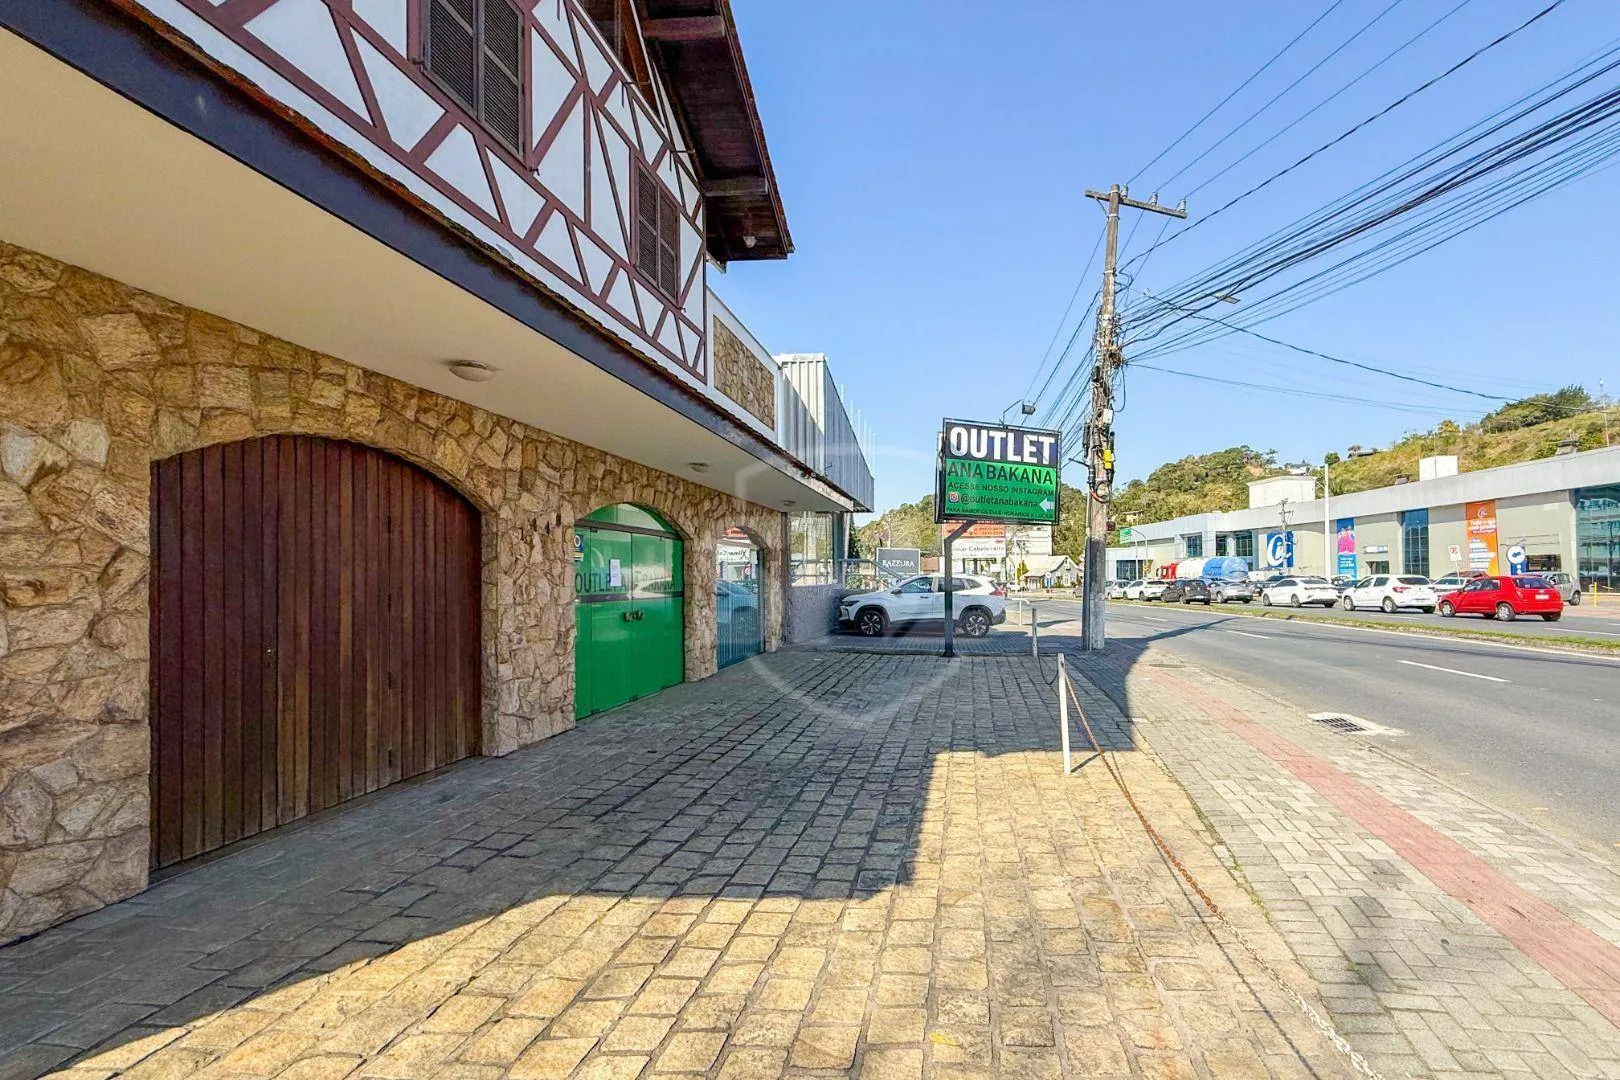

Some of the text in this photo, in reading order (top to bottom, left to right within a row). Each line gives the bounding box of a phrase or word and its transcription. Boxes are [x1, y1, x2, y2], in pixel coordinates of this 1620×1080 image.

[950, 427, 1055, 465] OUTLET
[947, 462, 1053, 485] ANA BAKANA
[948, 481, 1054, 497] ACESSE NOSSO INSTAGRAM
[882, 559, 915, 568] RAZZURA
